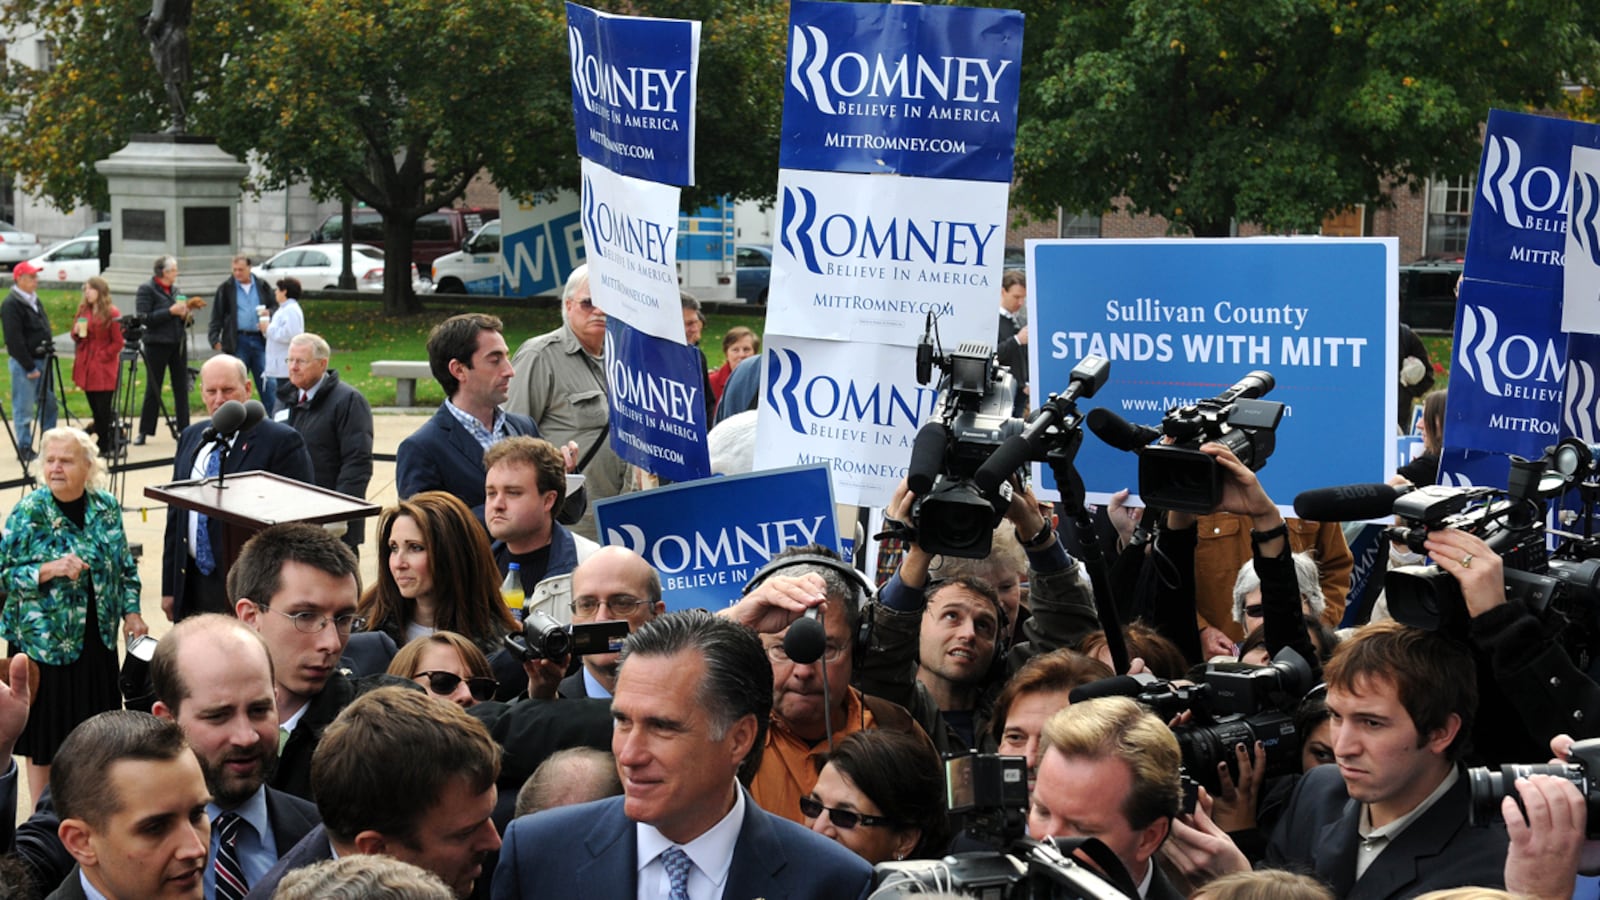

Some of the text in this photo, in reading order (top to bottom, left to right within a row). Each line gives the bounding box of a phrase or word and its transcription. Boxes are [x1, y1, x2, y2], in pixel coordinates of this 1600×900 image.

[568, 25, 687, 113] ROMNEY
[790, 25, 1013, 115] ROMNEY
[624, 113, 680, 132] AMERICA
[837, 101, 1001, 124] BELIEVE IN AMERICA
[583, 172, 675, 267] ROMNEY
[780, 185, 1001, 275] ROMNEY
[1525, 215, 1567, 233] BELIE
[826, 262, 990, 287] BELIEVE IN AMERICA
[1106, 298, 1310, 331] Sullivan County
[1051, 331, 1368, 368] STANDS WITH MITT
[604, 330, 698, 425] ROMNEY
[766, 347, 939, 434] ROMN
[659, 418, 699, 443] AMERICA
[810, 422, 867, 445] BELIEVE
[875, 431, 893, 446] IN
[667, 570, 728, 591] BELIEVE
[731, 568, 748, 583] IN
